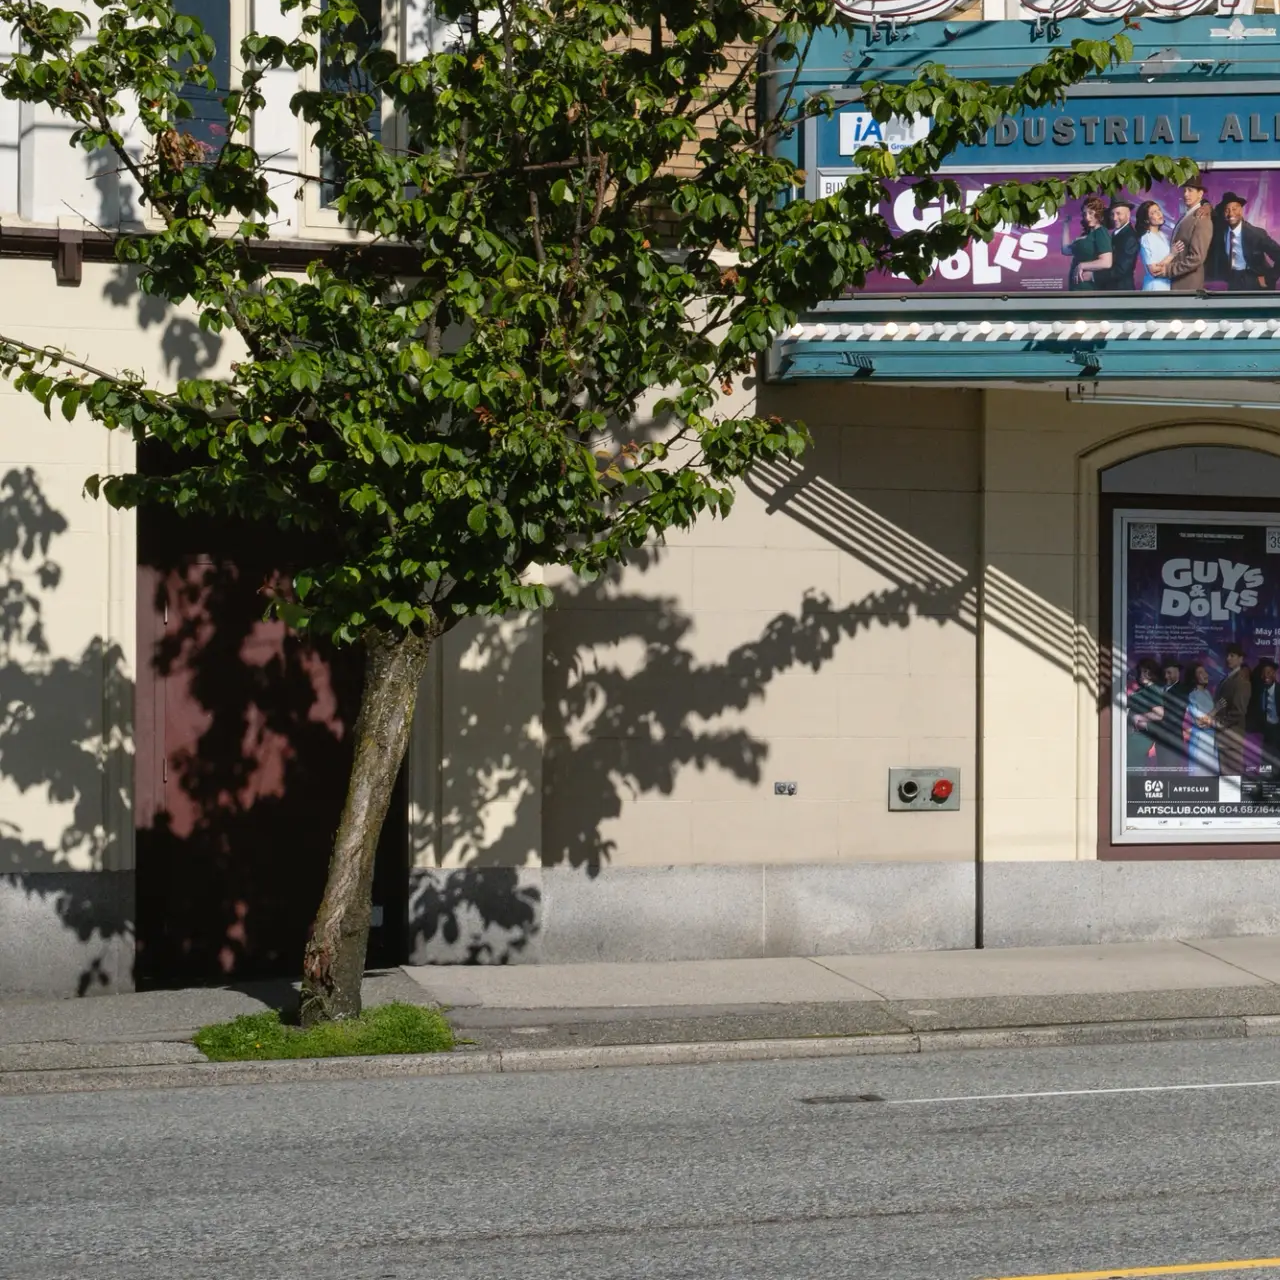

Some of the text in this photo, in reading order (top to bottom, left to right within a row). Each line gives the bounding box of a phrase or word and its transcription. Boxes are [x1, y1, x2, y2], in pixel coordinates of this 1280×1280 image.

[965, 113, 1200, 146] DUSTRIAL
[1161, 558, 1264, 590] GUYS
[1189, 584, 1206, 597] &
[1160, 589, 1258, 621] DOLLS
[1255, 628, 1272, 636] May
[1137, 806, 1280, 814] ARTSCLUB.COM 604.687.1644
